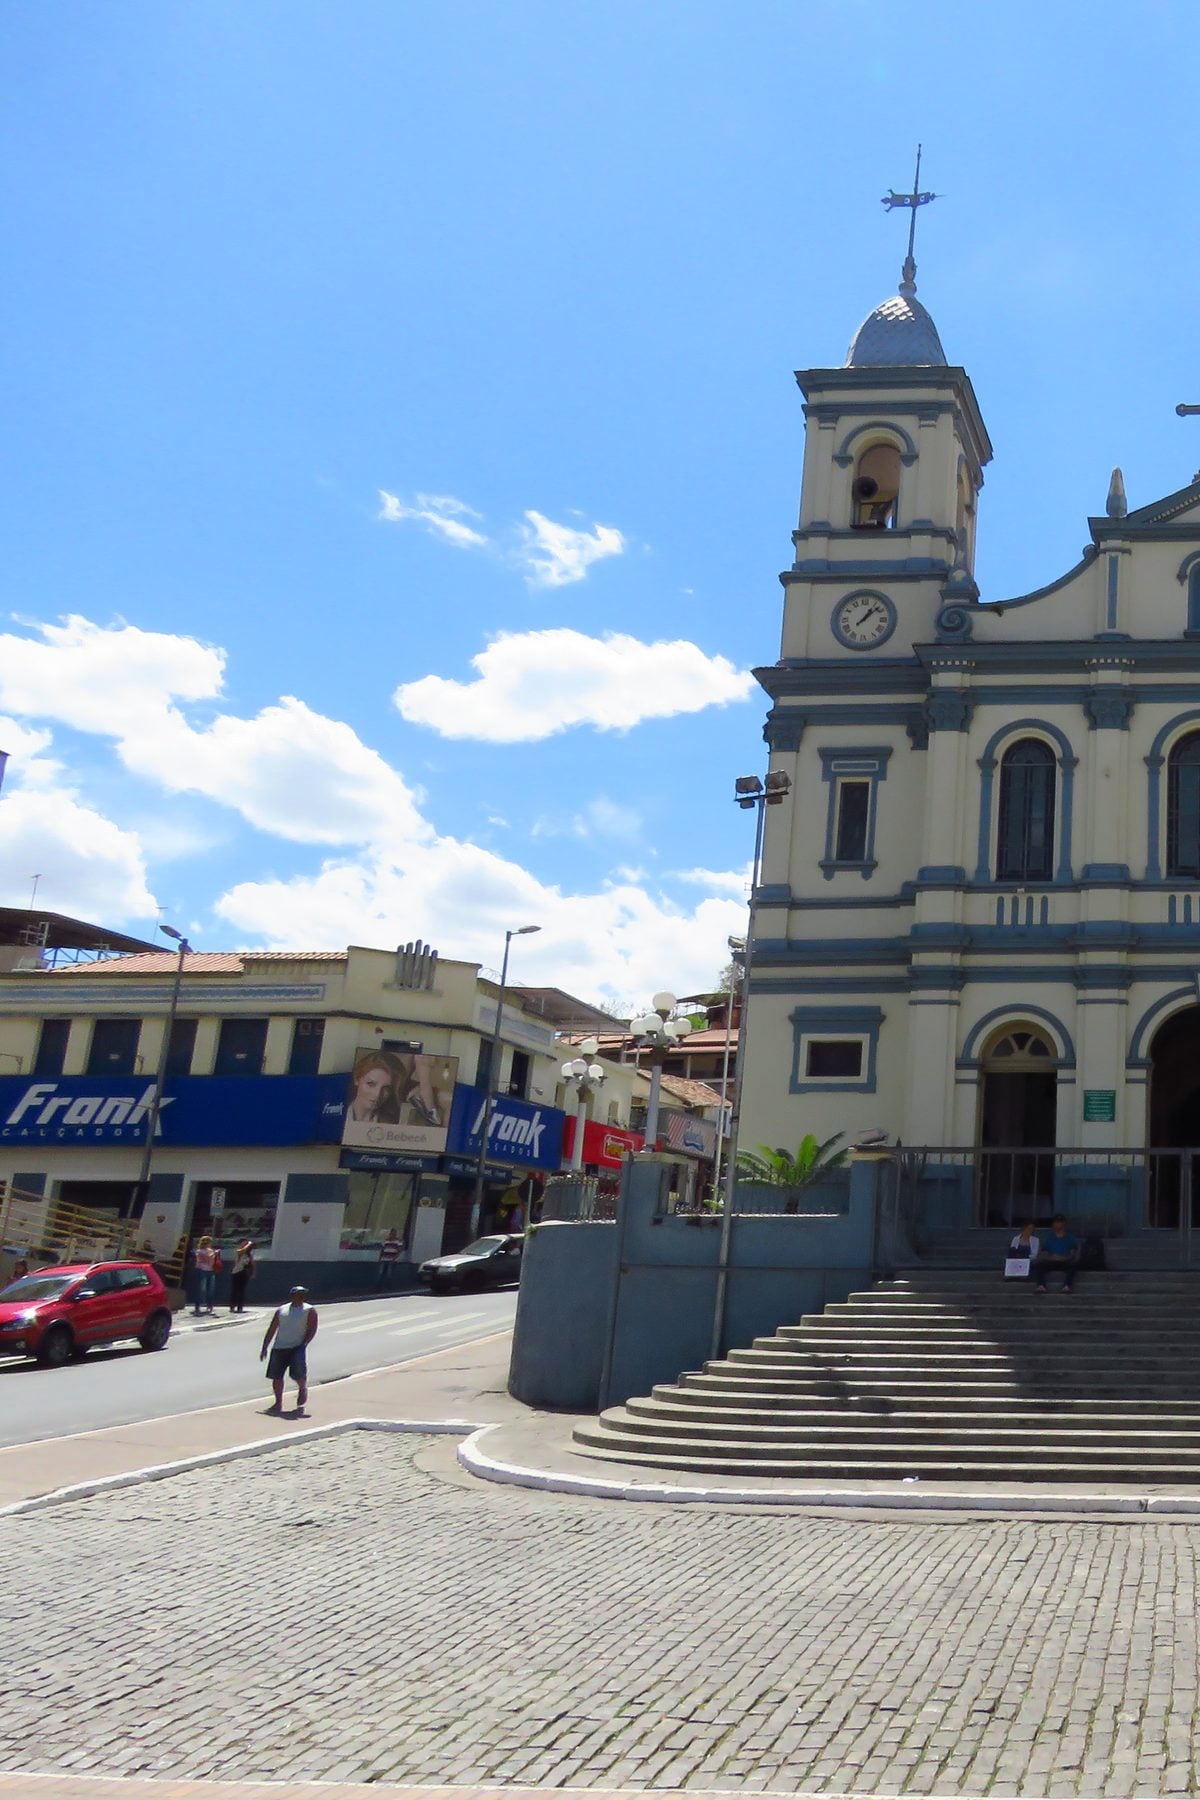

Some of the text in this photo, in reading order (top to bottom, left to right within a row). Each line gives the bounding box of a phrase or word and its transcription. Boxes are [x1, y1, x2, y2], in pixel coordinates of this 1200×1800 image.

[2, 1128, 141, 1138] CALÇADOS
[5, 1083, 177, 1136] Frank
[471, 1099, 547, 1158] Frank
